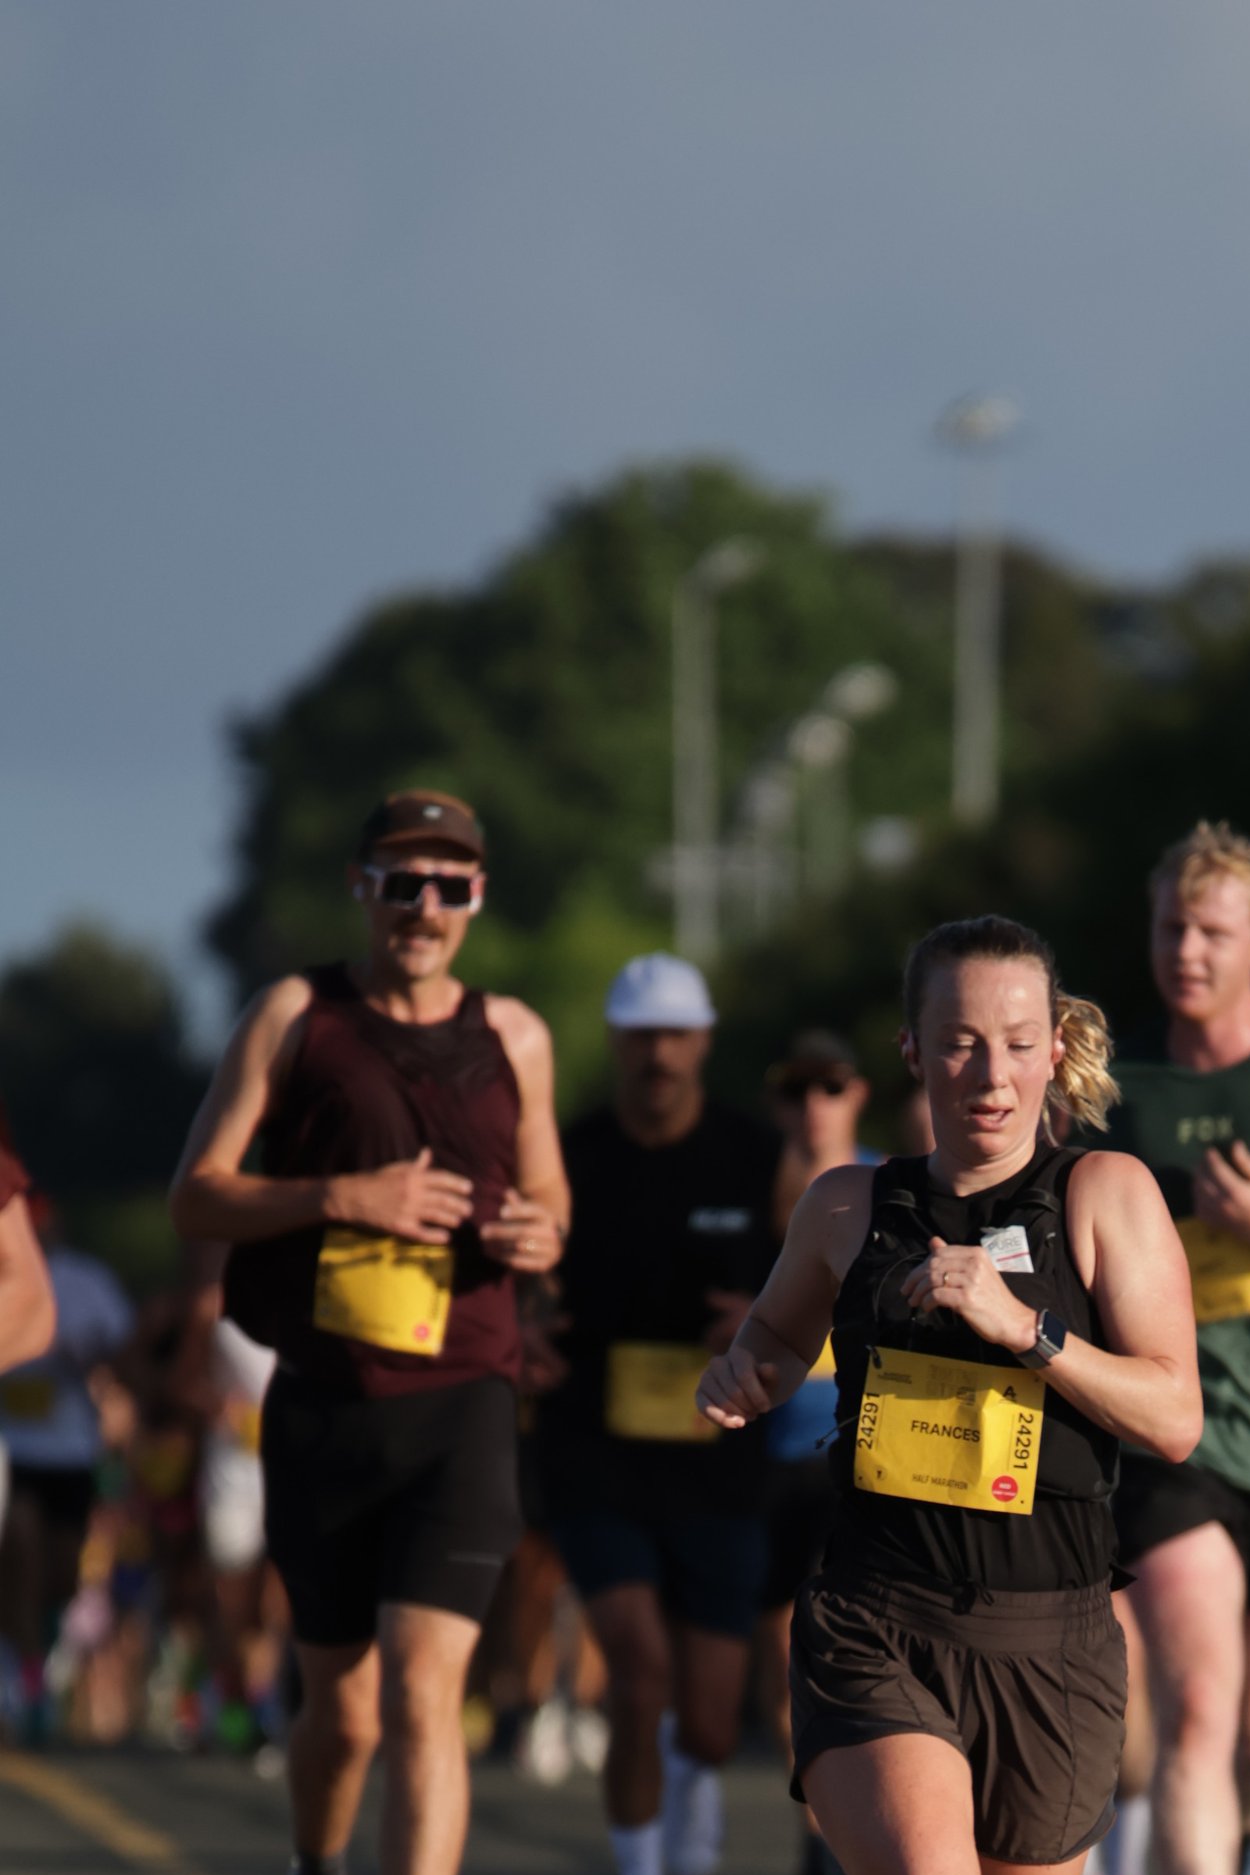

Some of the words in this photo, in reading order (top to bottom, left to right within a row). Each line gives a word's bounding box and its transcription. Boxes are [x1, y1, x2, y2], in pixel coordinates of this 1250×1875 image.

[1177, 1116, 1233, 1144] FOX
[1003, 1385, 1017, 1400] A
[858, 1392, 881, 1450] 24291
[910, 1419, 981, 1443] FRANCES
[1013, 1413, 1034, 1471] 24291
[930, 1476, 968, 1490] MARATHON
